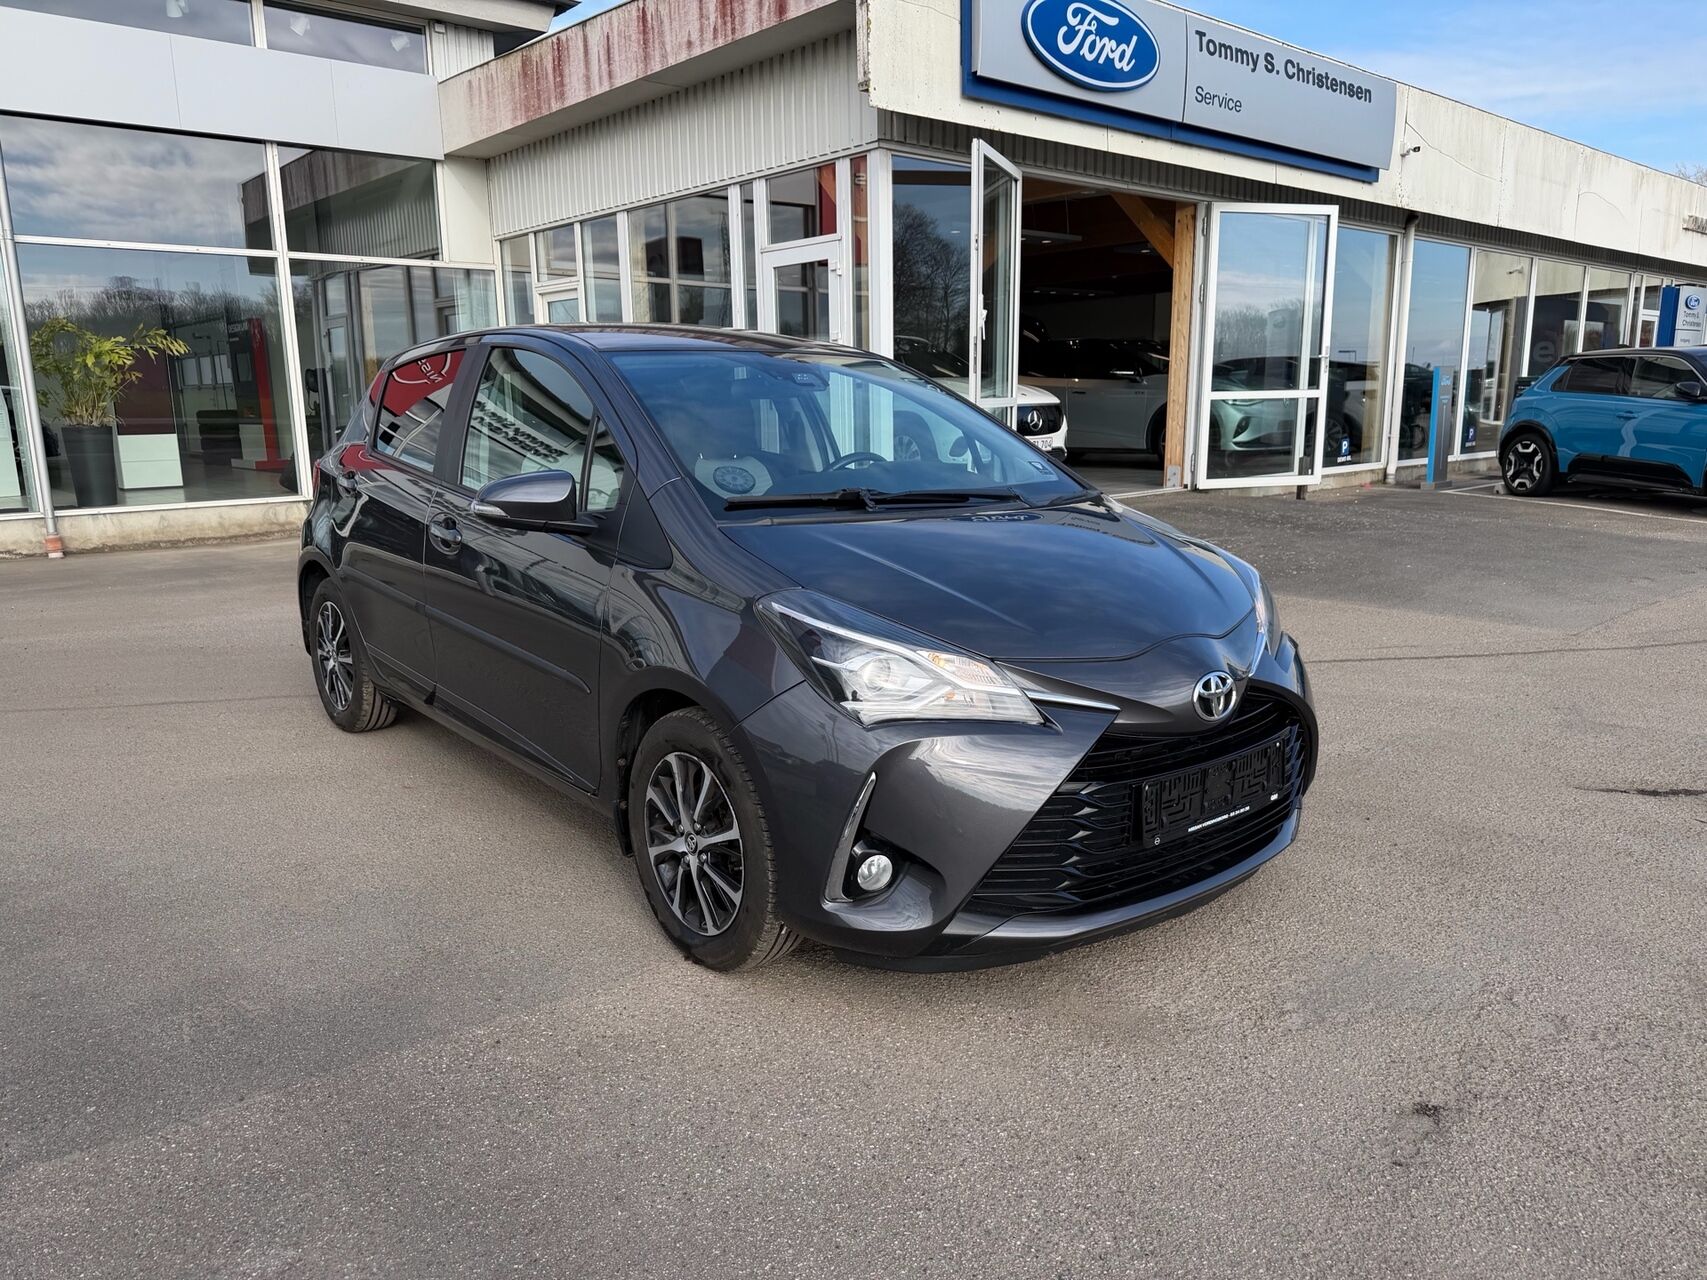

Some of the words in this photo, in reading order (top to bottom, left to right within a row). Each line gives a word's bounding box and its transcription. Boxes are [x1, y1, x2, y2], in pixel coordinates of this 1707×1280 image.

[1056, 2, 1138, 72] Ford
[1195, 30, 1259, 72] Tommy
[1264, 53, 1280, 76] S.
[1283, 60, 1373, 103] Christensen
[1195, 86, 1242, 113] Service
[1041, 440, 1052, 448] 704
[1342, 440, 1348, 453] P
